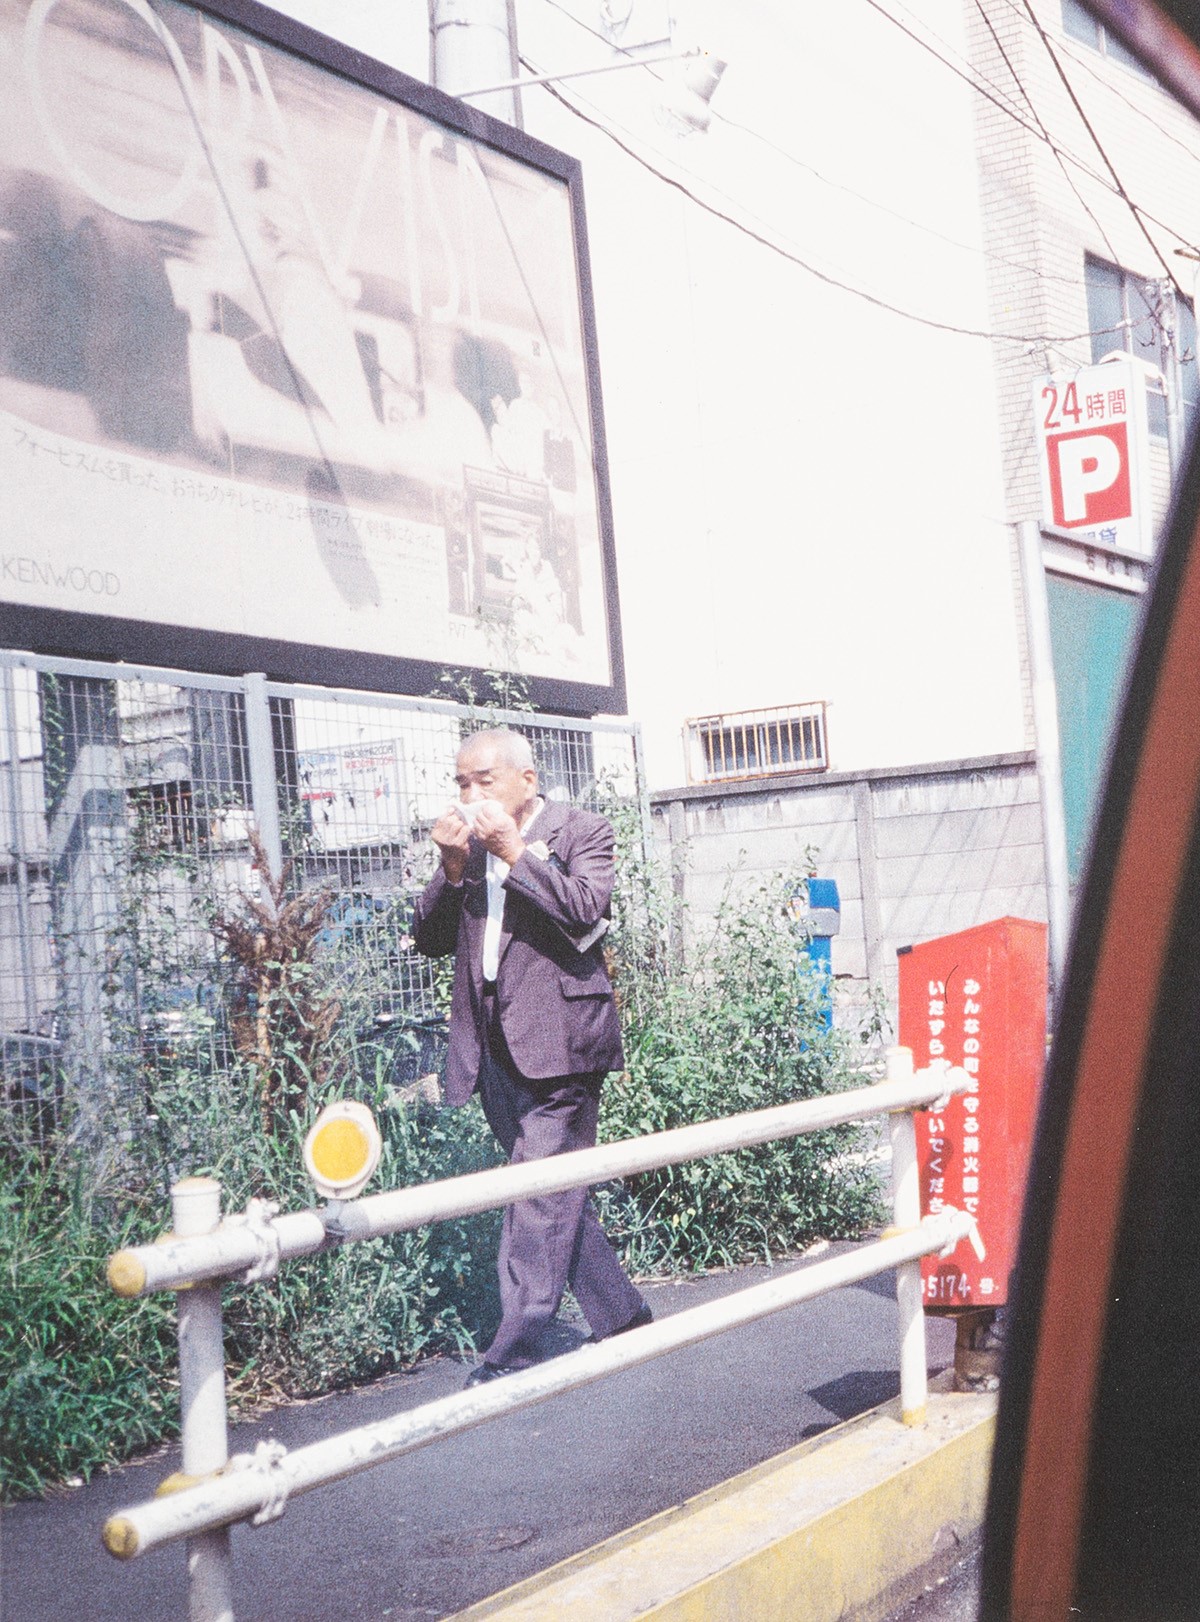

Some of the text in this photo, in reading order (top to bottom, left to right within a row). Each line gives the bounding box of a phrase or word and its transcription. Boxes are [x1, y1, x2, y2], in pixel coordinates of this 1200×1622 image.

[1042, 381, 1127, 429] 24時間
[1058, 434, 1121, 522] P
[1, 557, 121, 597] KENWOOD
